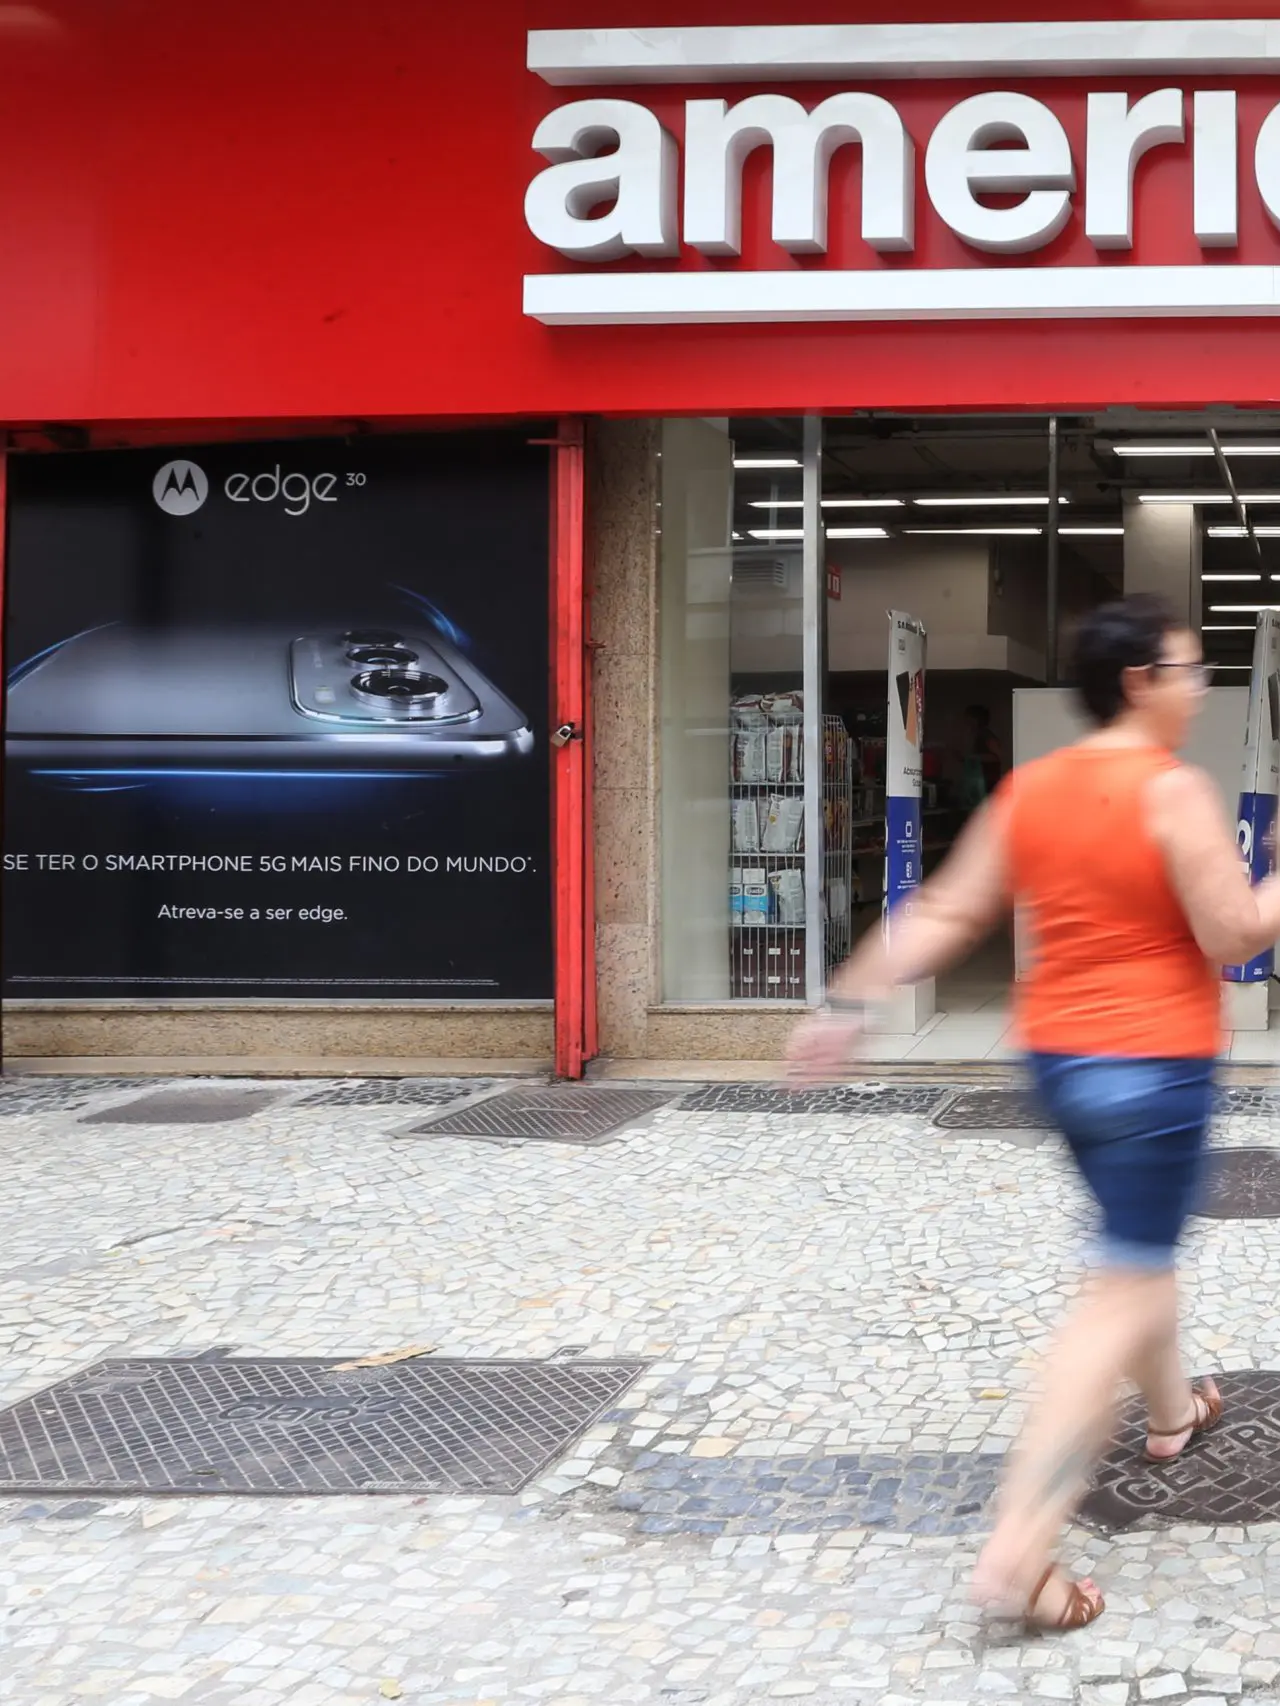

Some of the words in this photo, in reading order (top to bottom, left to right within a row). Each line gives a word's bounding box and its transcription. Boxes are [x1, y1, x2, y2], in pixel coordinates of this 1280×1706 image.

[224, 464, 338, 516] edge
[346, 472, 367, 487] 30
[36, 854, 76, 871] TER
[82, 854, 99, 871] O
[105, 855, 253, 872] SMARTPHONE
[259, 856, 286, 872] 5G
[291, 856, 342, 872] MAIS
[349, 856, 400, 872] FINO
[407, 857, 438, 872] DO
[158, 904, 244, 920] Atreva-se
[249, 907, 260, 919] a
[265, 908, 293, 920] ser
[298, 905, 348, 922] edge.
[218, 1402, 360, 1423] Claro
